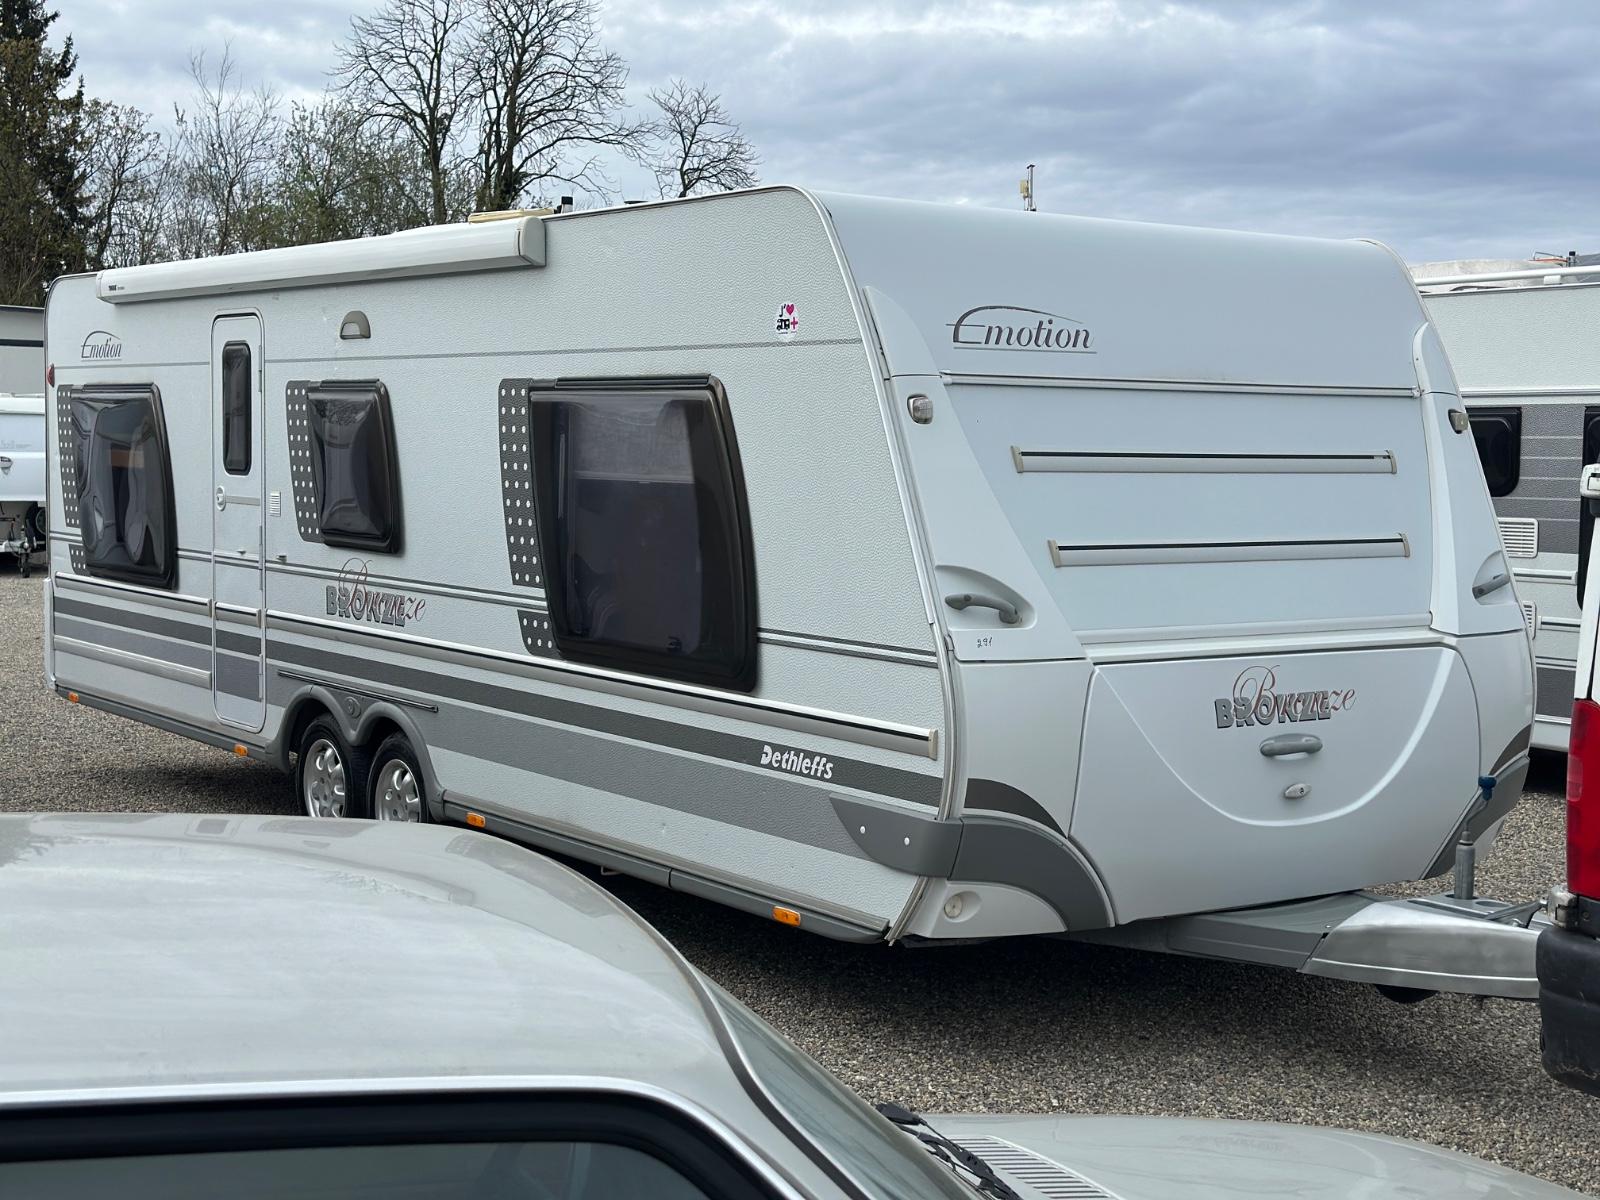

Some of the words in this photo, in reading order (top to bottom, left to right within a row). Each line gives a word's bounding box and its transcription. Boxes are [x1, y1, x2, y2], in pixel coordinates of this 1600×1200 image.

[81, 330, 122, 358] Emotion
[946, 305, 1095, 348] Emotion
[760, 744, 834, 779] Dethleffs
